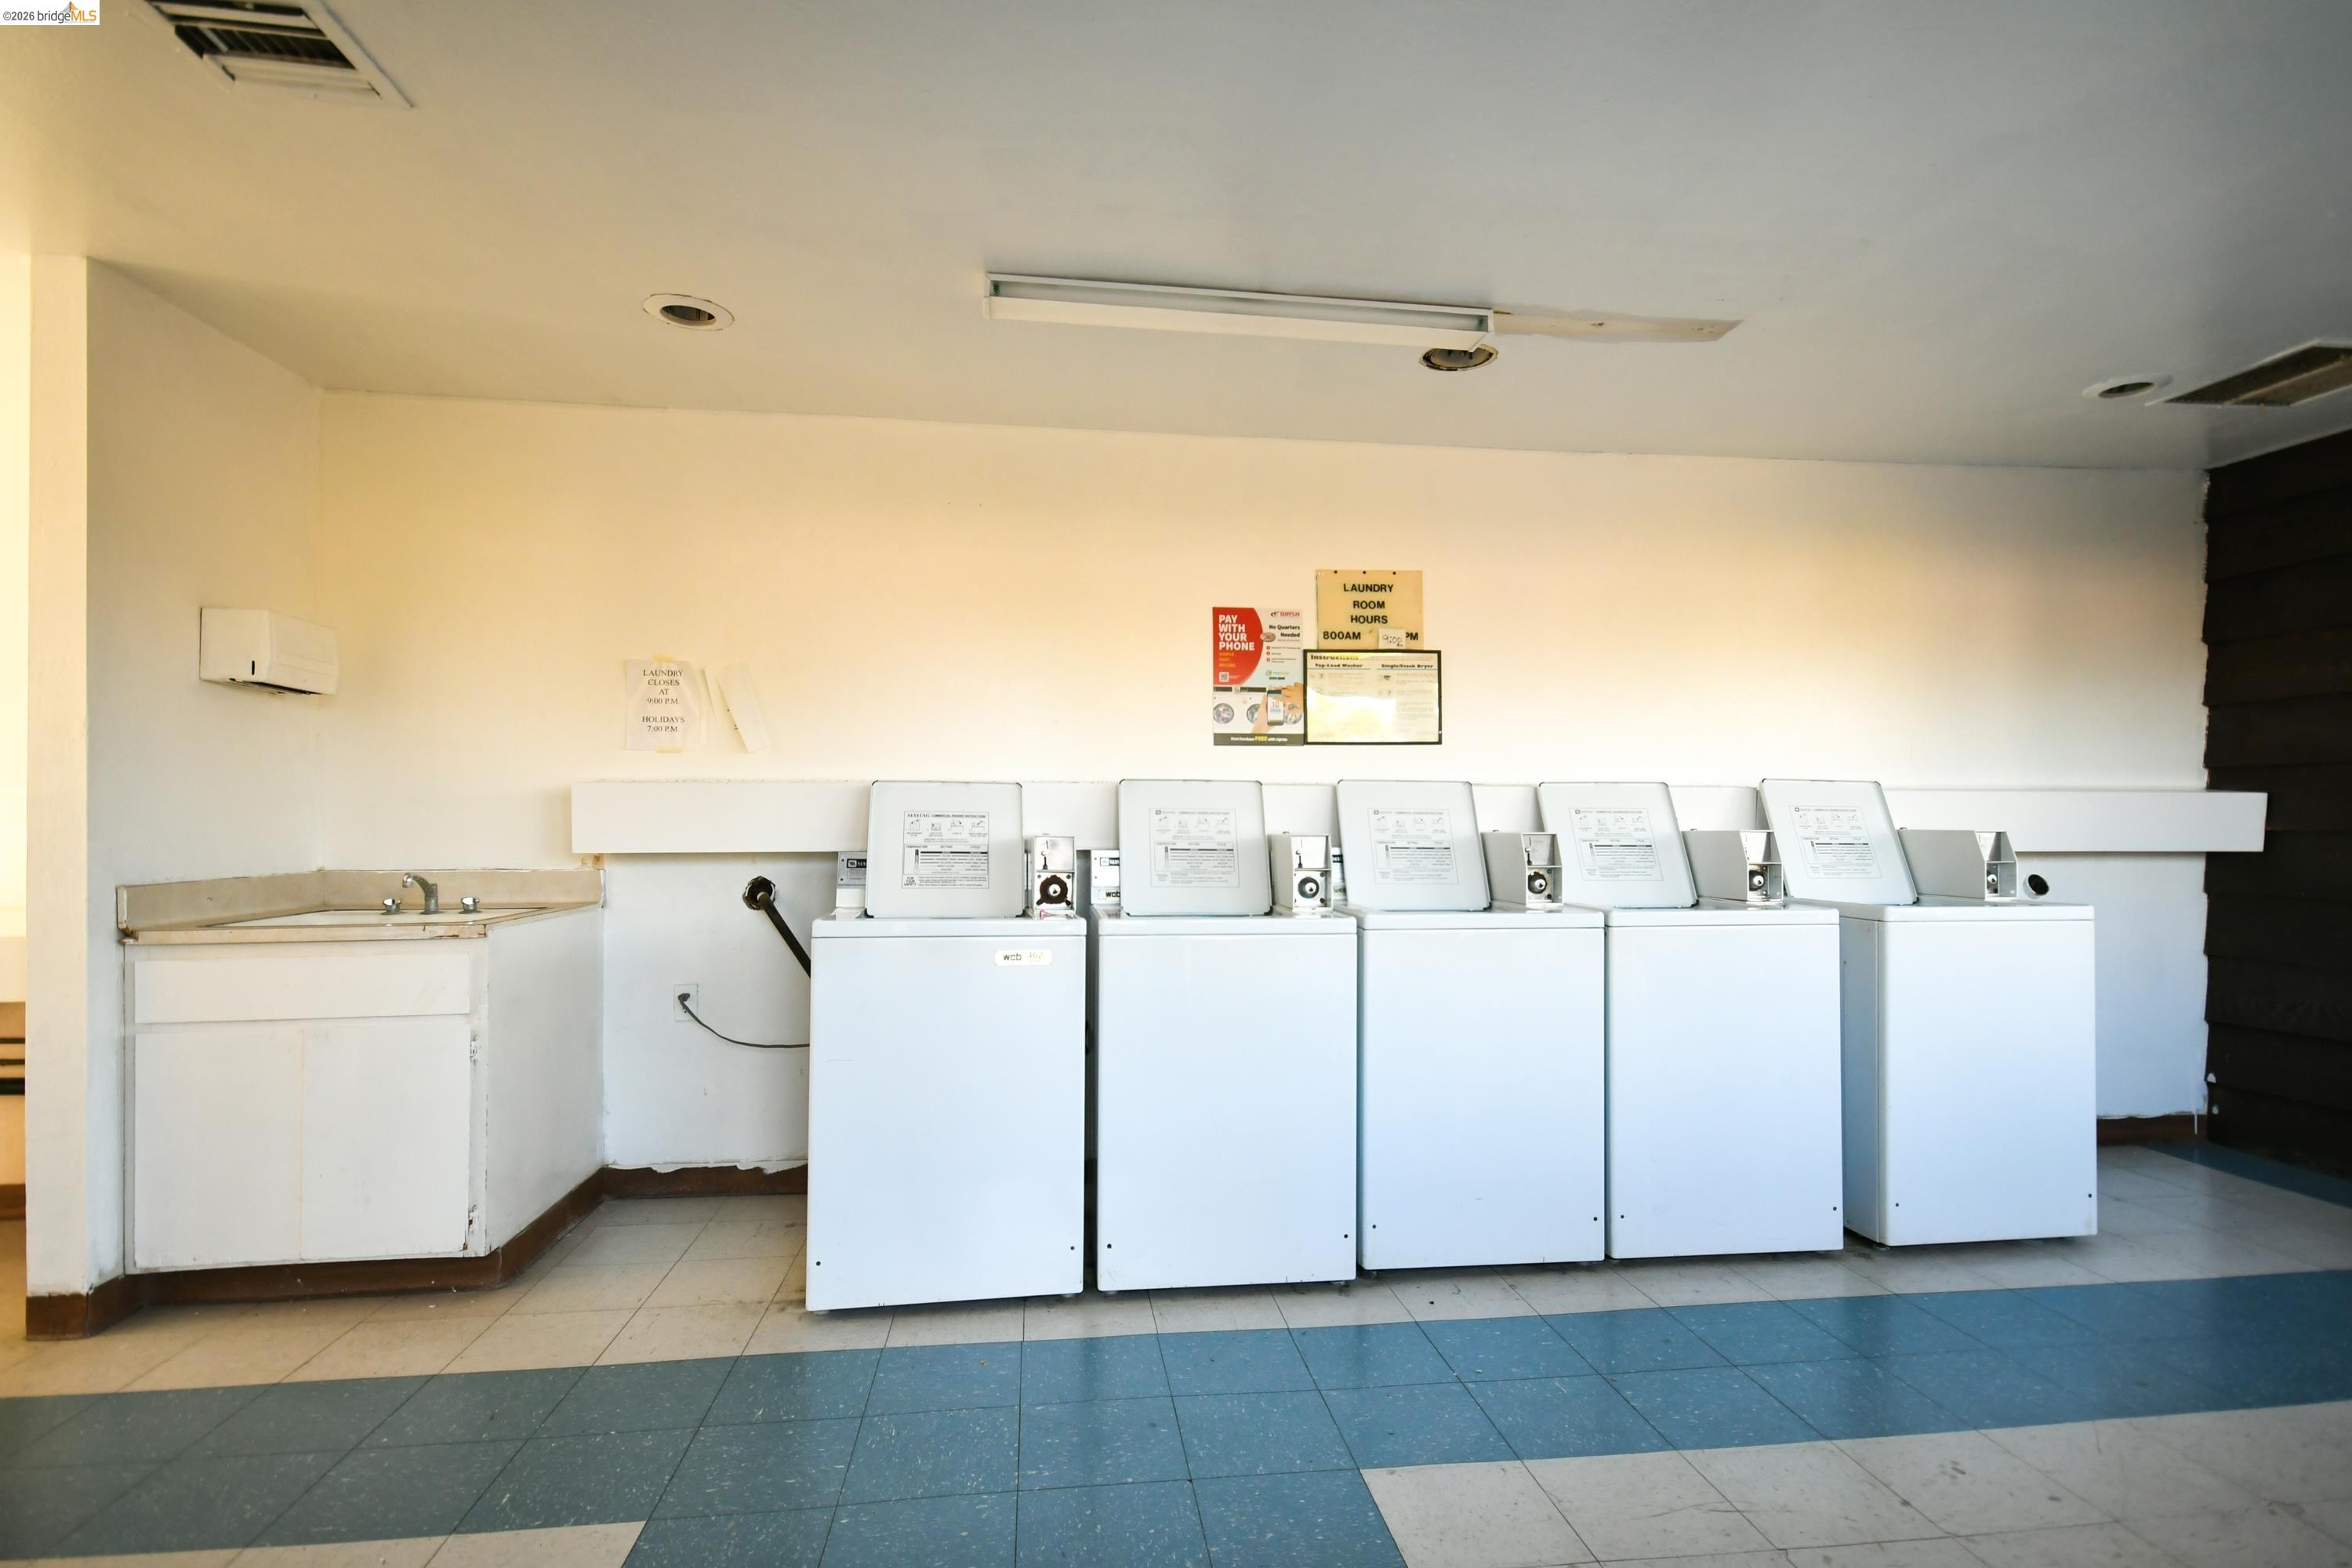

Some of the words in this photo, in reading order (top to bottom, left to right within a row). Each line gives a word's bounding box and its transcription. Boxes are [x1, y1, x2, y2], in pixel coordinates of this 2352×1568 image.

[1343, 583, 1394, 593] LAUNDRY
[1352, 601, 1385, 609] ROOM
[1218, 615, 1238, 623] PAY
[1350, 615, 1388, 624] HOURS
[1218, 624, 1245, 633] WITH
[1218, 633, 1247, 641] YOUR
[1323, 631, 1361, 640] 800AM
[1218, 642, 1254, 651] PHONE
